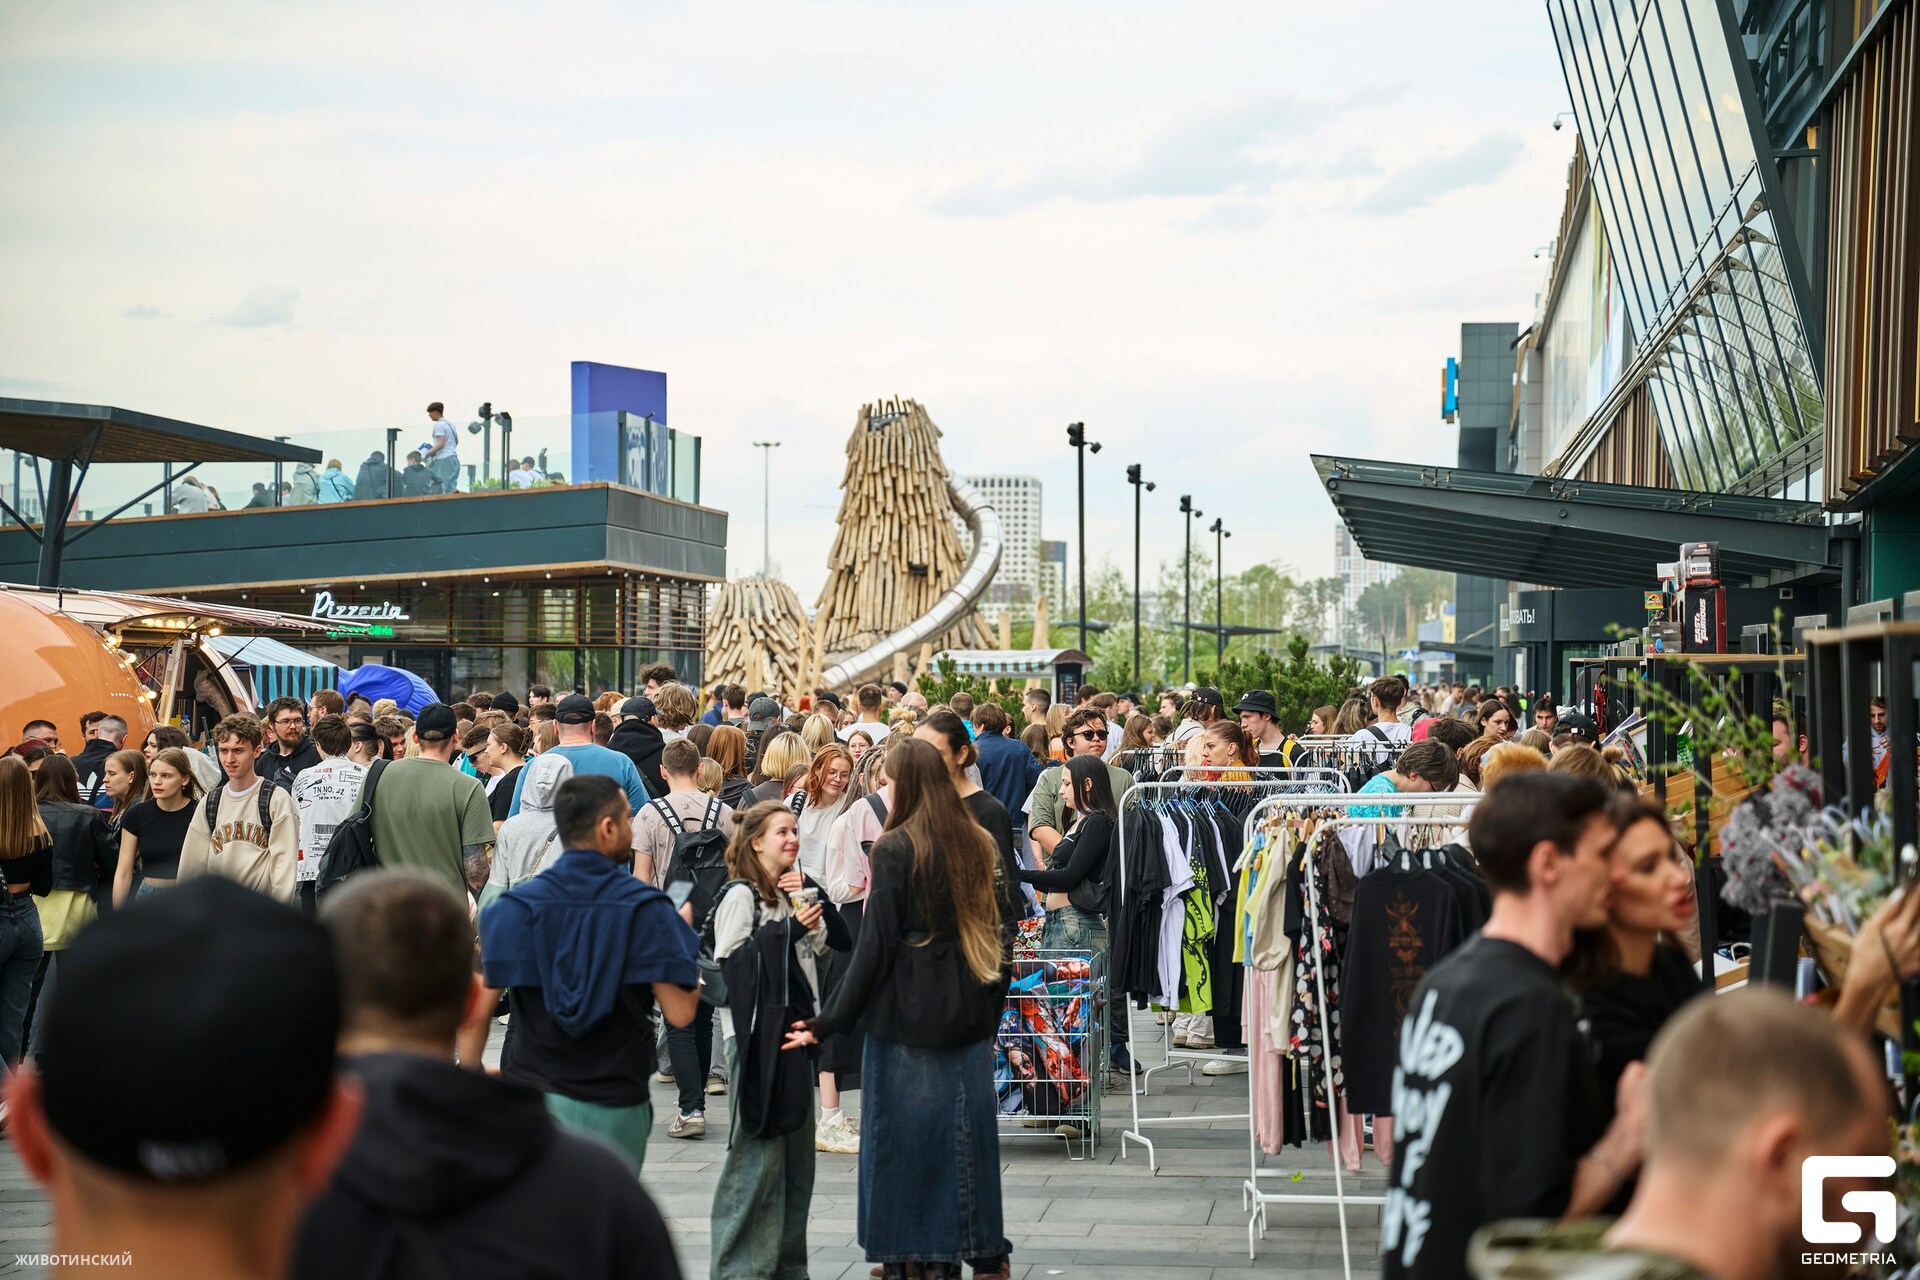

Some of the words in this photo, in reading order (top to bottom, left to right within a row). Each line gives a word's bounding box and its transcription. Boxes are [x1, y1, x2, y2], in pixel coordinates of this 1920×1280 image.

[311, 591, 409, 620] Pizzeria
[1699, 598, 1709, 642] FURIOUS
[1694, 616, 1703, 644] FAST
